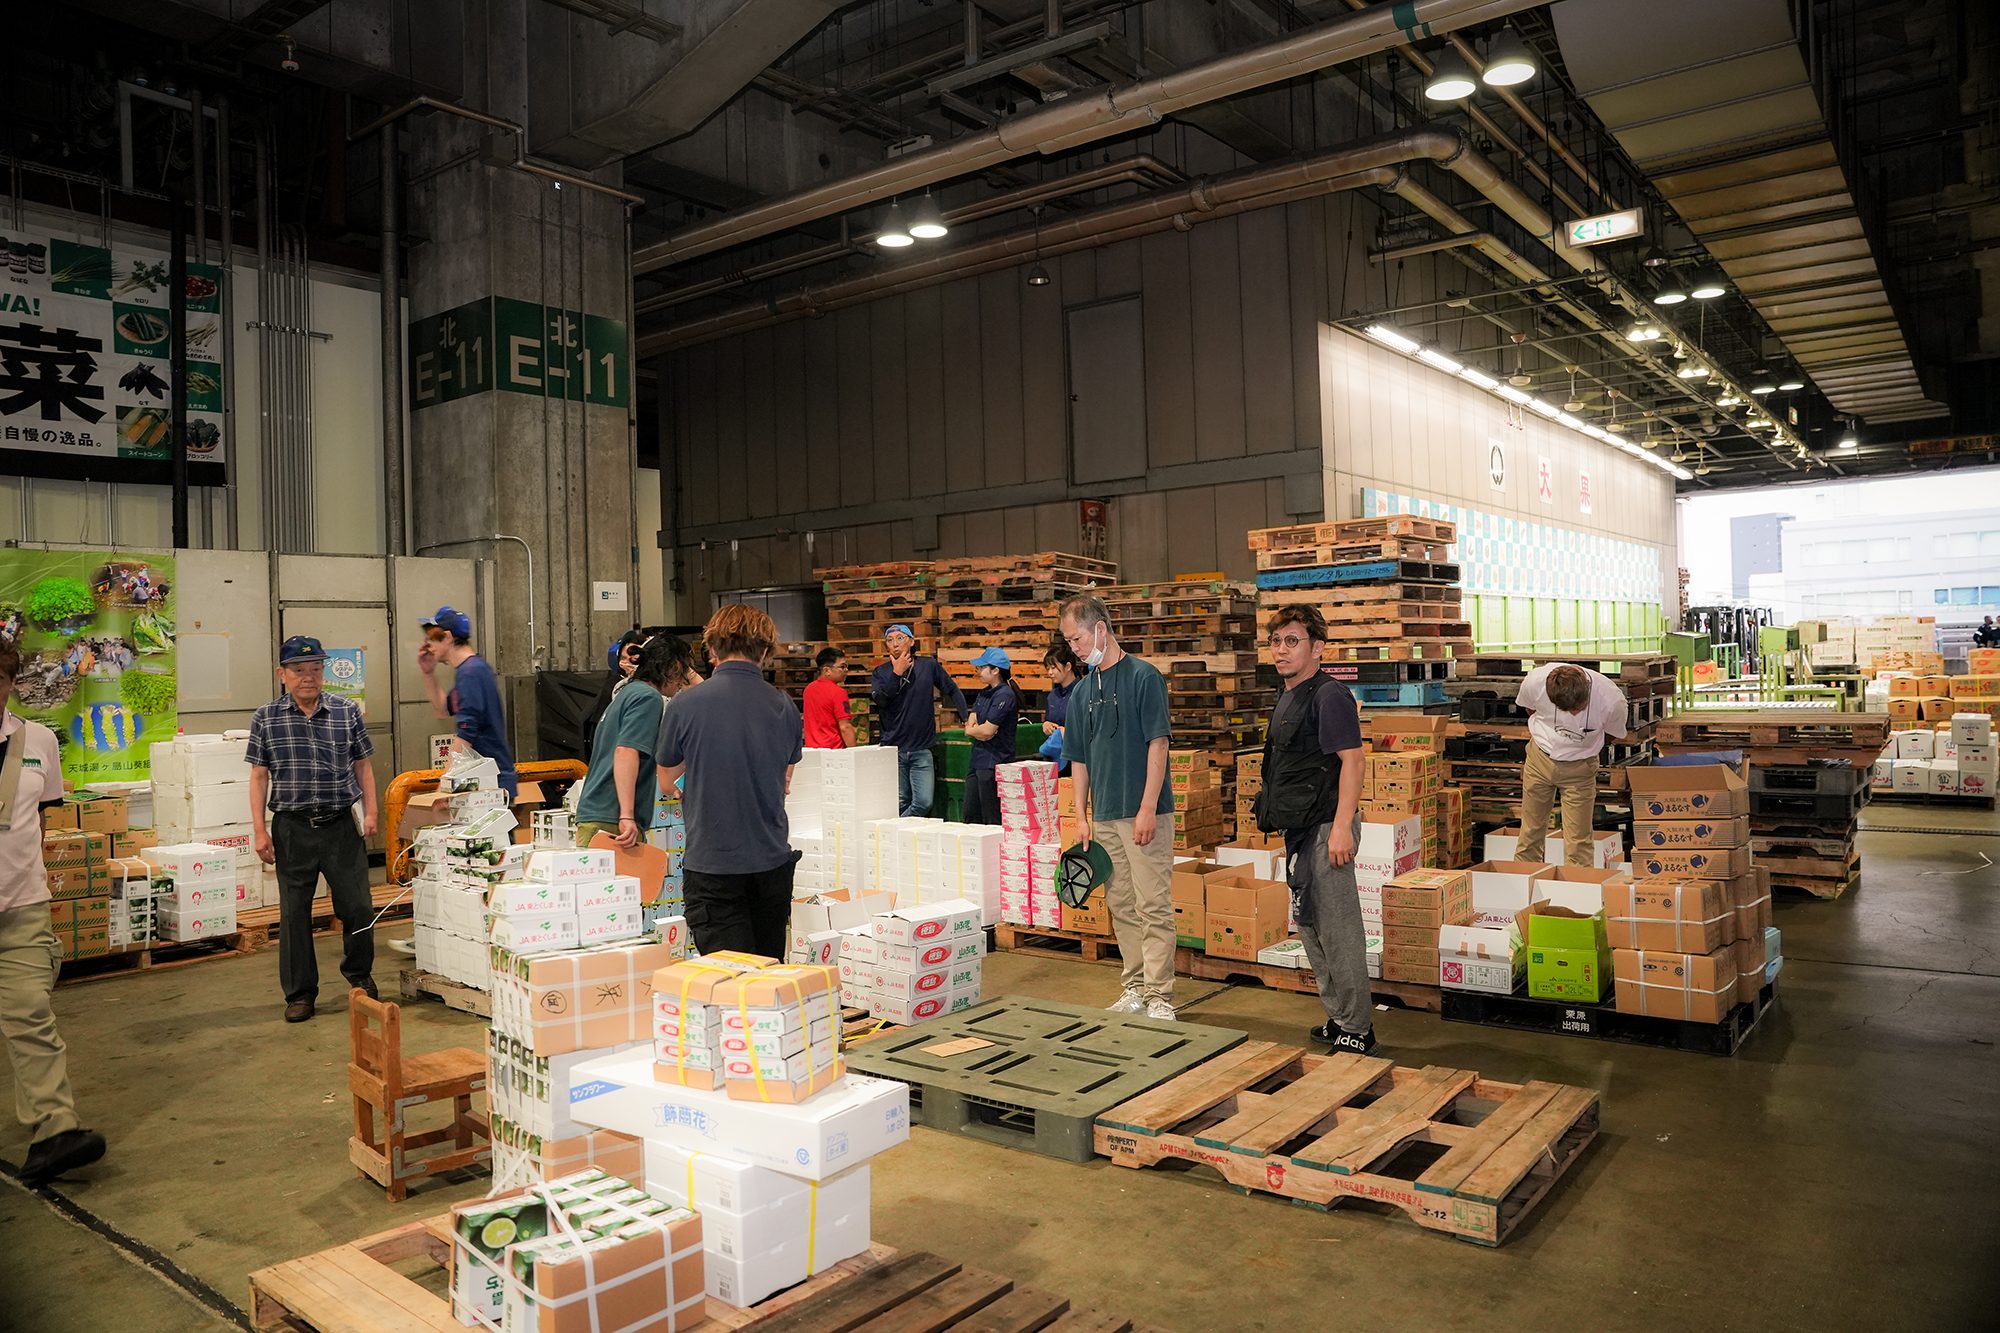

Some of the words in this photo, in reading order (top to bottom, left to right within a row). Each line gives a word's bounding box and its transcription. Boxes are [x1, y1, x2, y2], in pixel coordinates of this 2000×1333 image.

[439, 317, 456, 348] 北
[550, 315, 577, 348] 北
[416, 336, 482, 400] E-11
[510, 335, 615, 398] E-11
[0, 322, 107, 425] 菜
[0, 426, 102, 448] 自慢の逸品。
[127, 449, 163, 458] スイートコーン
[1540, 462, 1552, 498] 大
[1665, 804, 1691, 813] まるなす
[1668, 834, 1693, 843] まるなす
[558, 869, 567, 877] JA
[569, 867, 595, 876] 東とくしま
[1665, 864, 1690, 873] まるなす
[91, 871, 107, 880] 大葉
[90, 902, 106, 910] 大葉
[515, 903, 526, 911] JA
[528, 901, 554, 910] 東とくしま
[584, 898, 594, 907] JA
[595, 895, 621, 905] 東とくしま
[587, 927, 597, 936] JA
[598, 925, 623, 934] 東とくしま
[519, 936, 530, 945] JA
[531, 933, 557, 943] 東とくしま
[1562, 1020, 1590, 1032] 出荷用
[572, 1084, 607, 1099] サンフラワー
[1106, 1133, 1138, 1147] PROPERTY
[1119, 1144, 1134, 1153] APM
